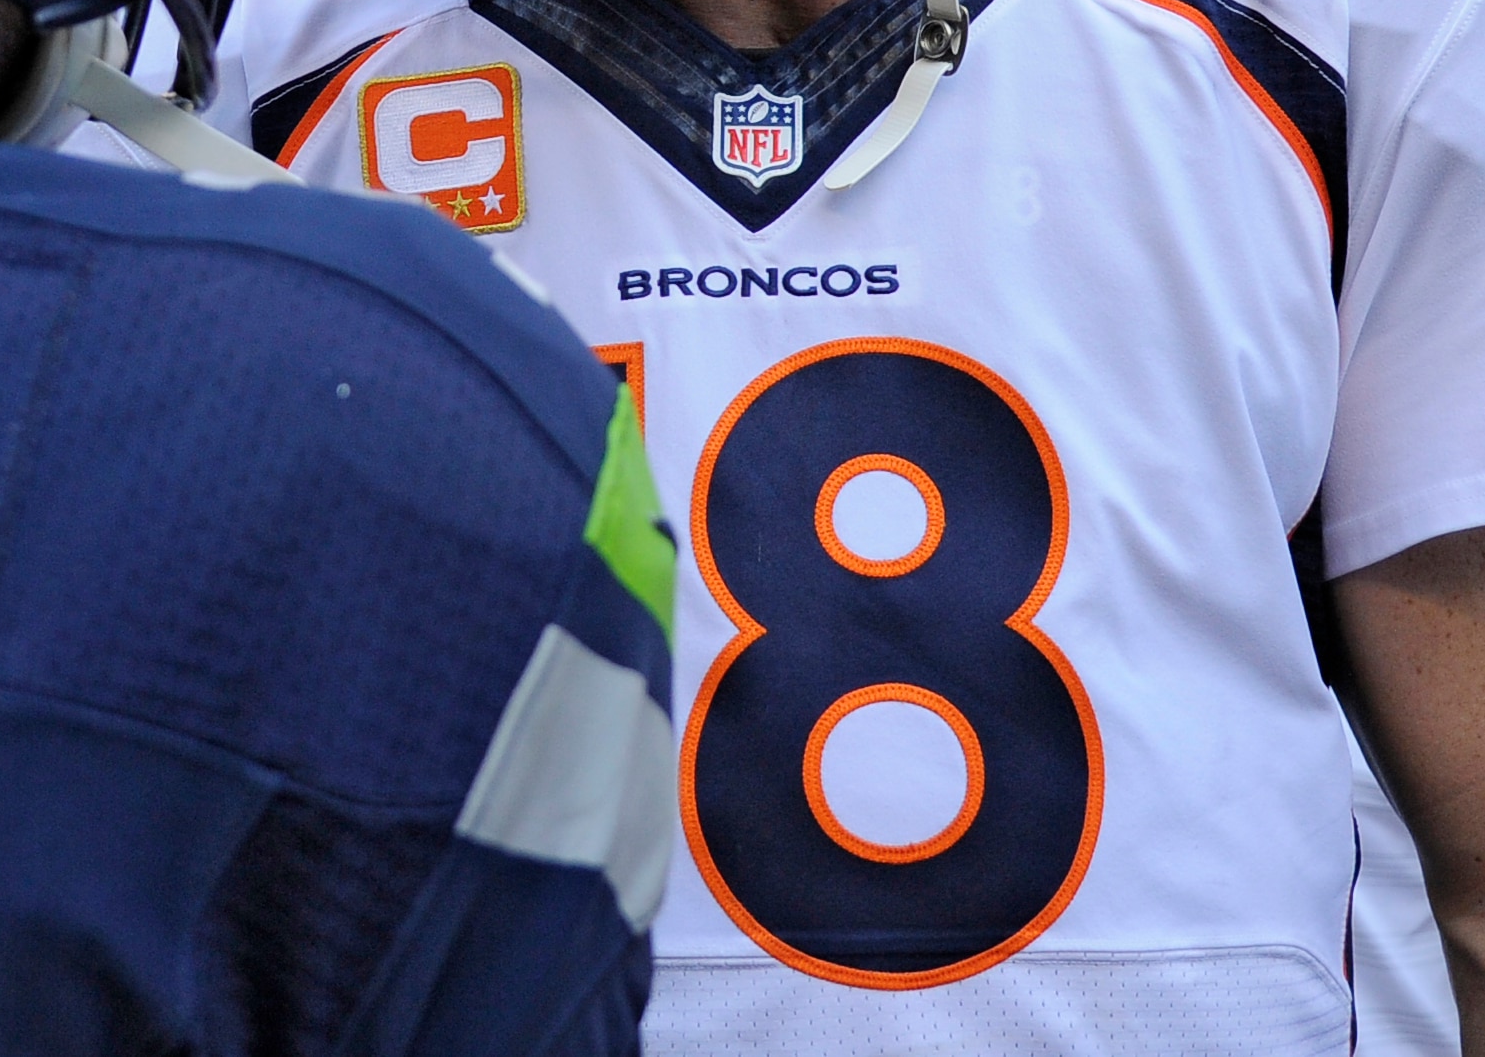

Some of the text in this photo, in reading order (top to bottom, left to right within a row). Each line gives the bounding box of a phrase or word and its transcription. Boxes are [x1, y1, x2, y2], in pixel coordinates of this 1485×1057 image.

[374, 77, 506, 195] C
[727, 126, 789, 167] NFL
[618, 264, 901, 301] BRONCOS
[591, 336, 1106, 993] 8
